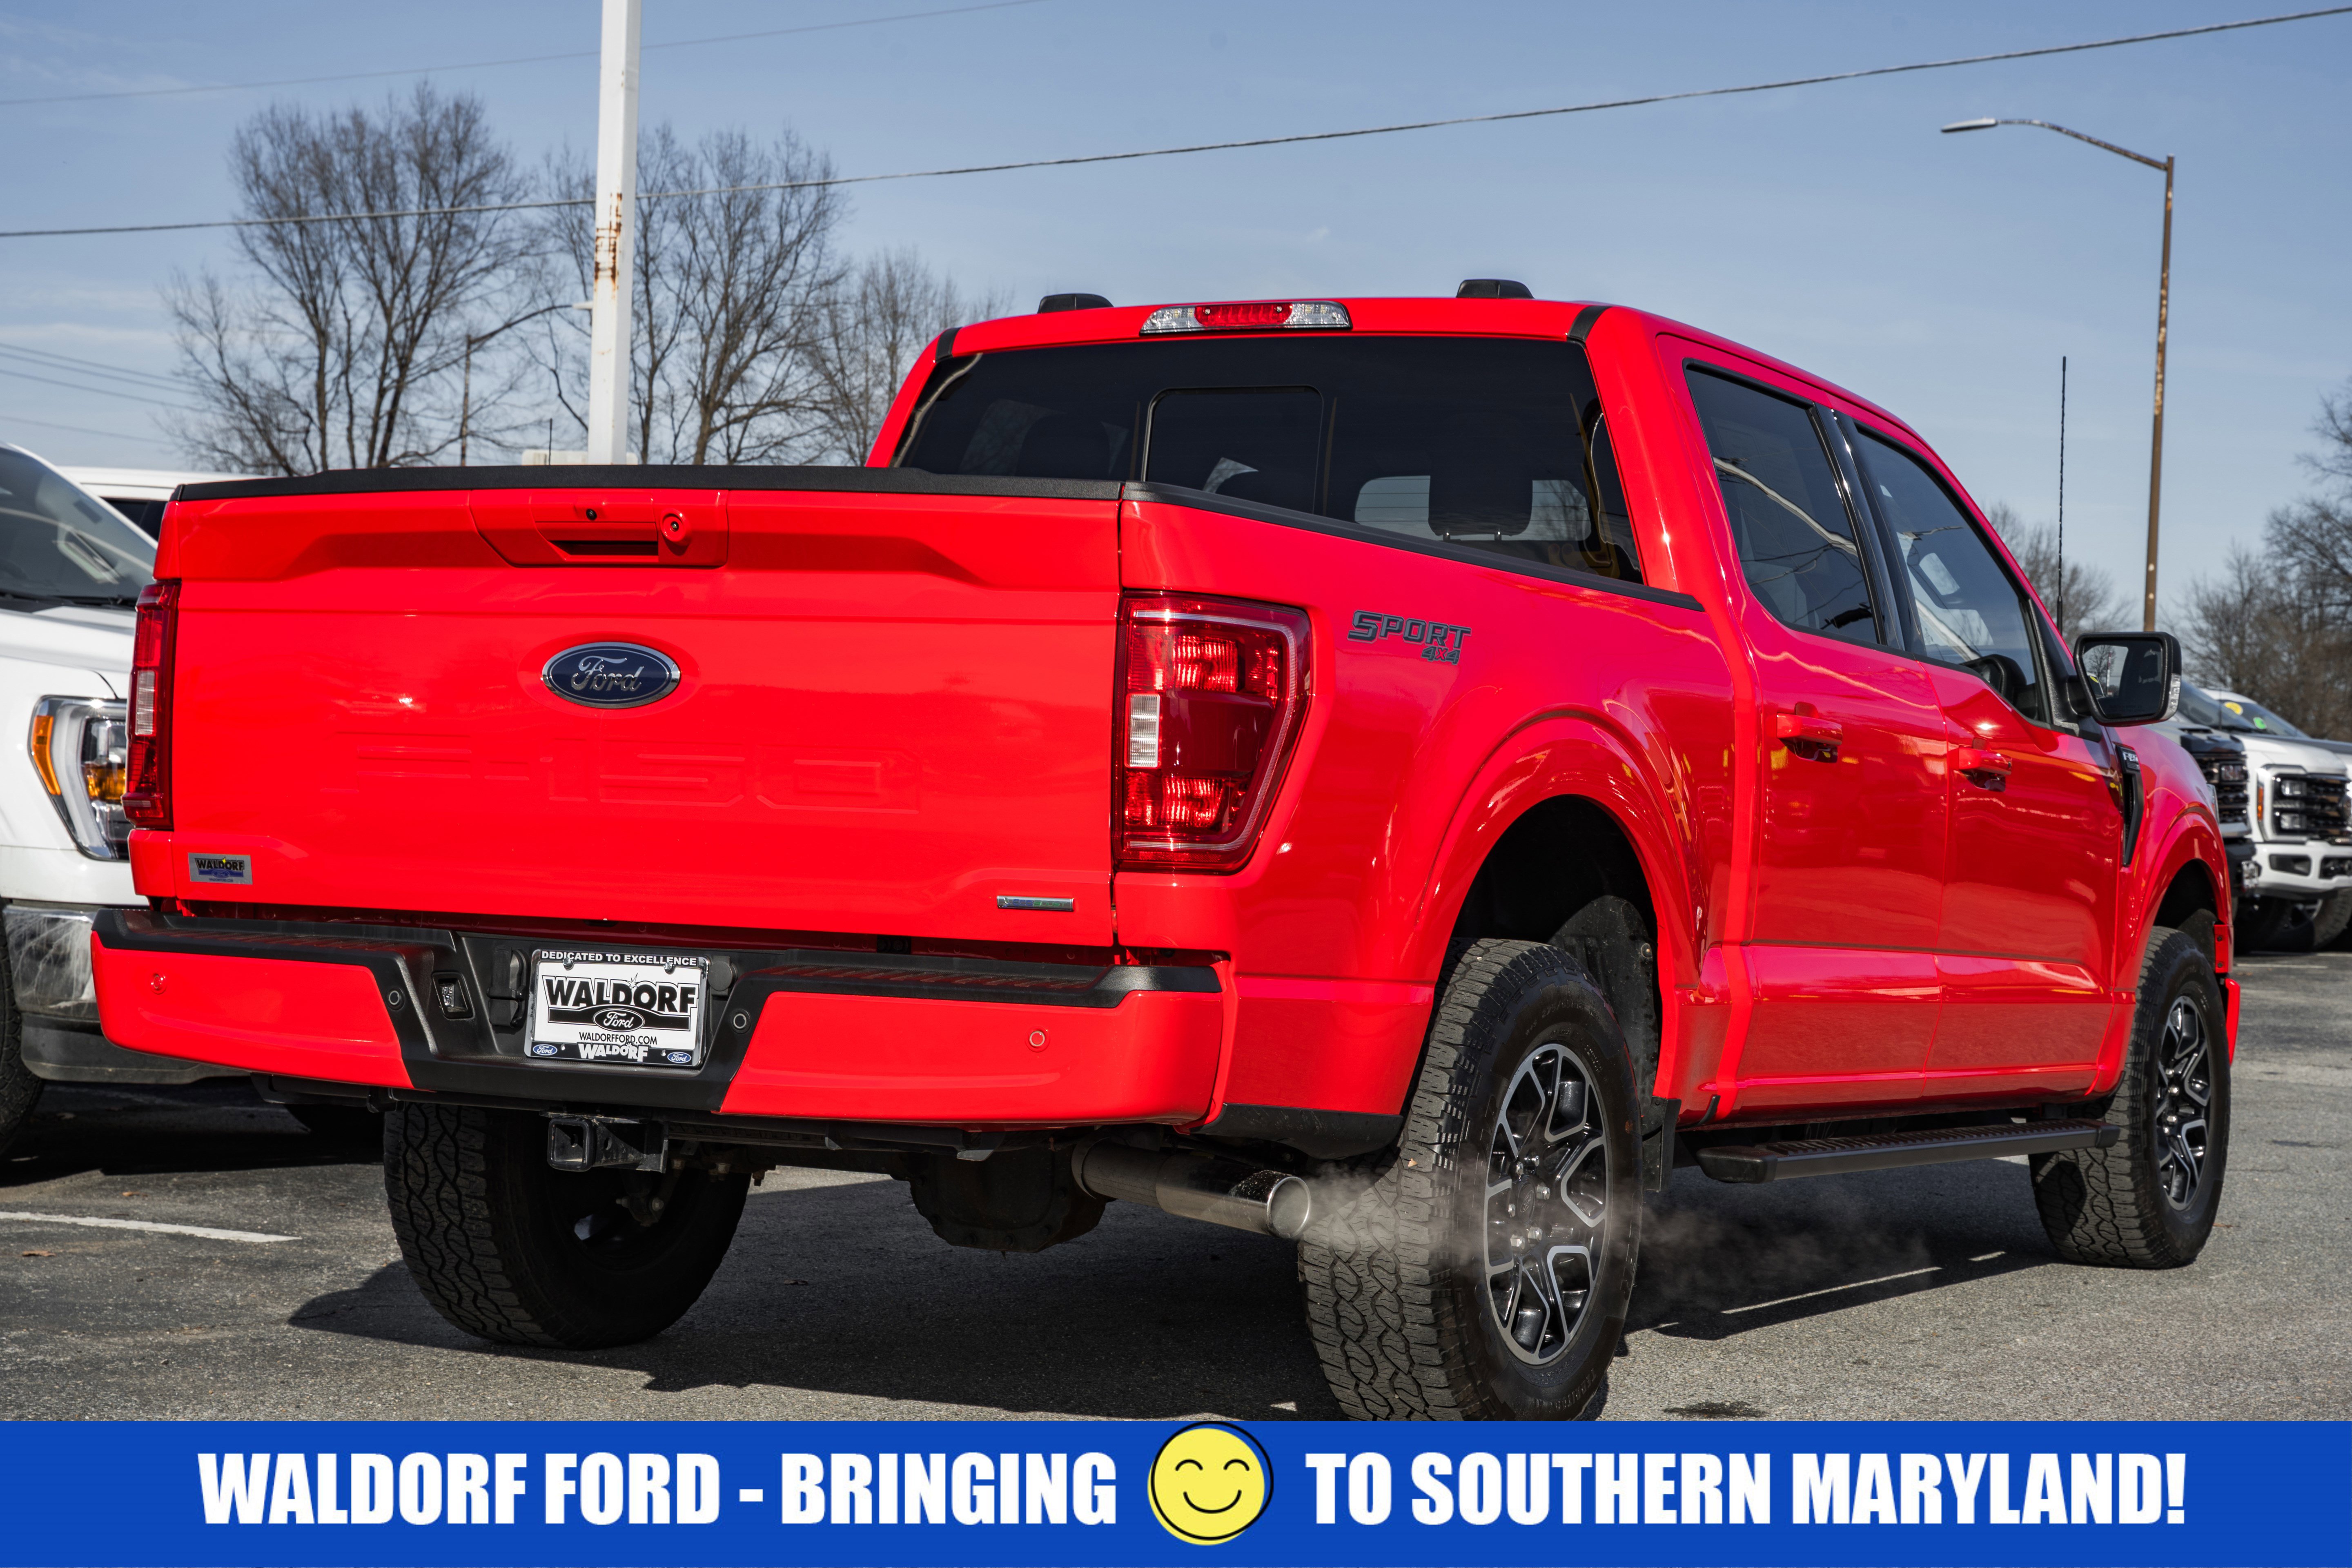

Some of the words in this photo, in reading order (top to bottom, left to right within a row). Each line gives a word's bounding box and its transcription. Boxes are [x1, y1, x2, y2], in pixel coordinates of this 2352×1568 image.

[1347, 609, 1472, 649] SPORT
[572, 655, 644, 692] Ford
[196, 859, 244, 871] WALDORF
[541, 951, 603, 962] DEDICATED
[606, 954, 621, 962] TO
[624, 954, 697, 966] EXCELLENCE
[545, 978, 697, 1013] WALDORF
[603, 1011, 634, 1029] Ford
[579, 1032, 657, 1045] WALDORFFORD.COM
[535, 1045, 554, 1055] Ford
[578, 1043, 648, 1062] WALDORF
[671, 1053, 688, 1062] Ford
